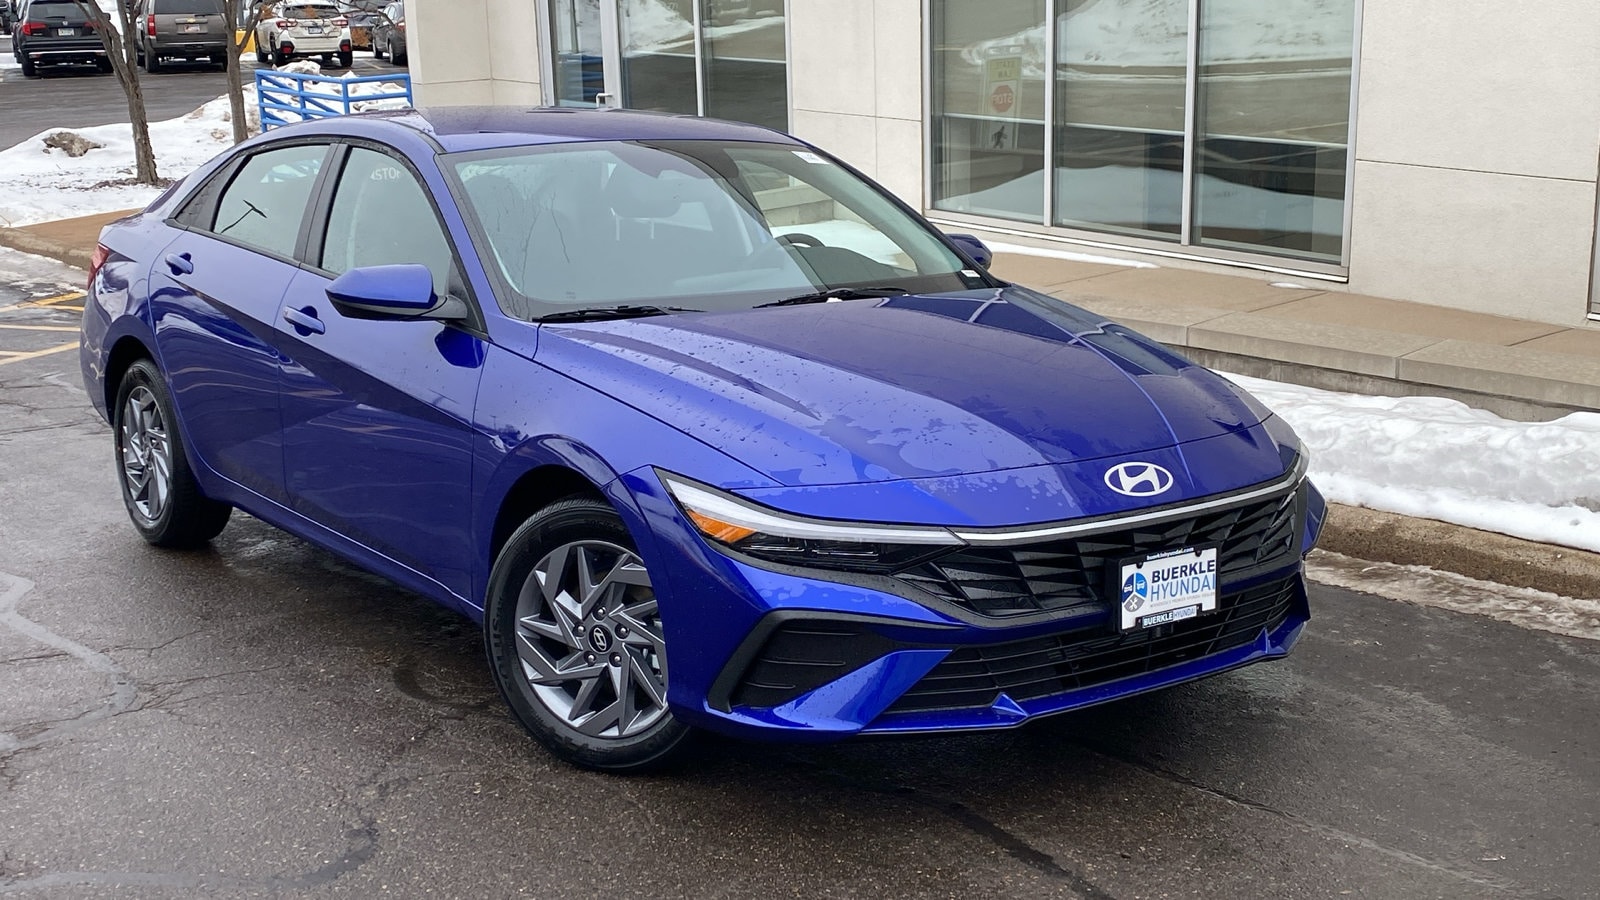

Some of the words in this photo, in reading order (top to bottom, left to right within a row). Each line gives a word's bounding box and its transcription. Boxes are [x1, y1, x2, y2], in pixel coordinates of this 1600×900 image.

[1151, 560, 1216, 583] BUERKLE
[1150, 573, 1216, 602] HYUNDAI
[1143, 612, 1173, 626] BUERKLE
[1173, 607, 1195, 619] HYUNDAI
